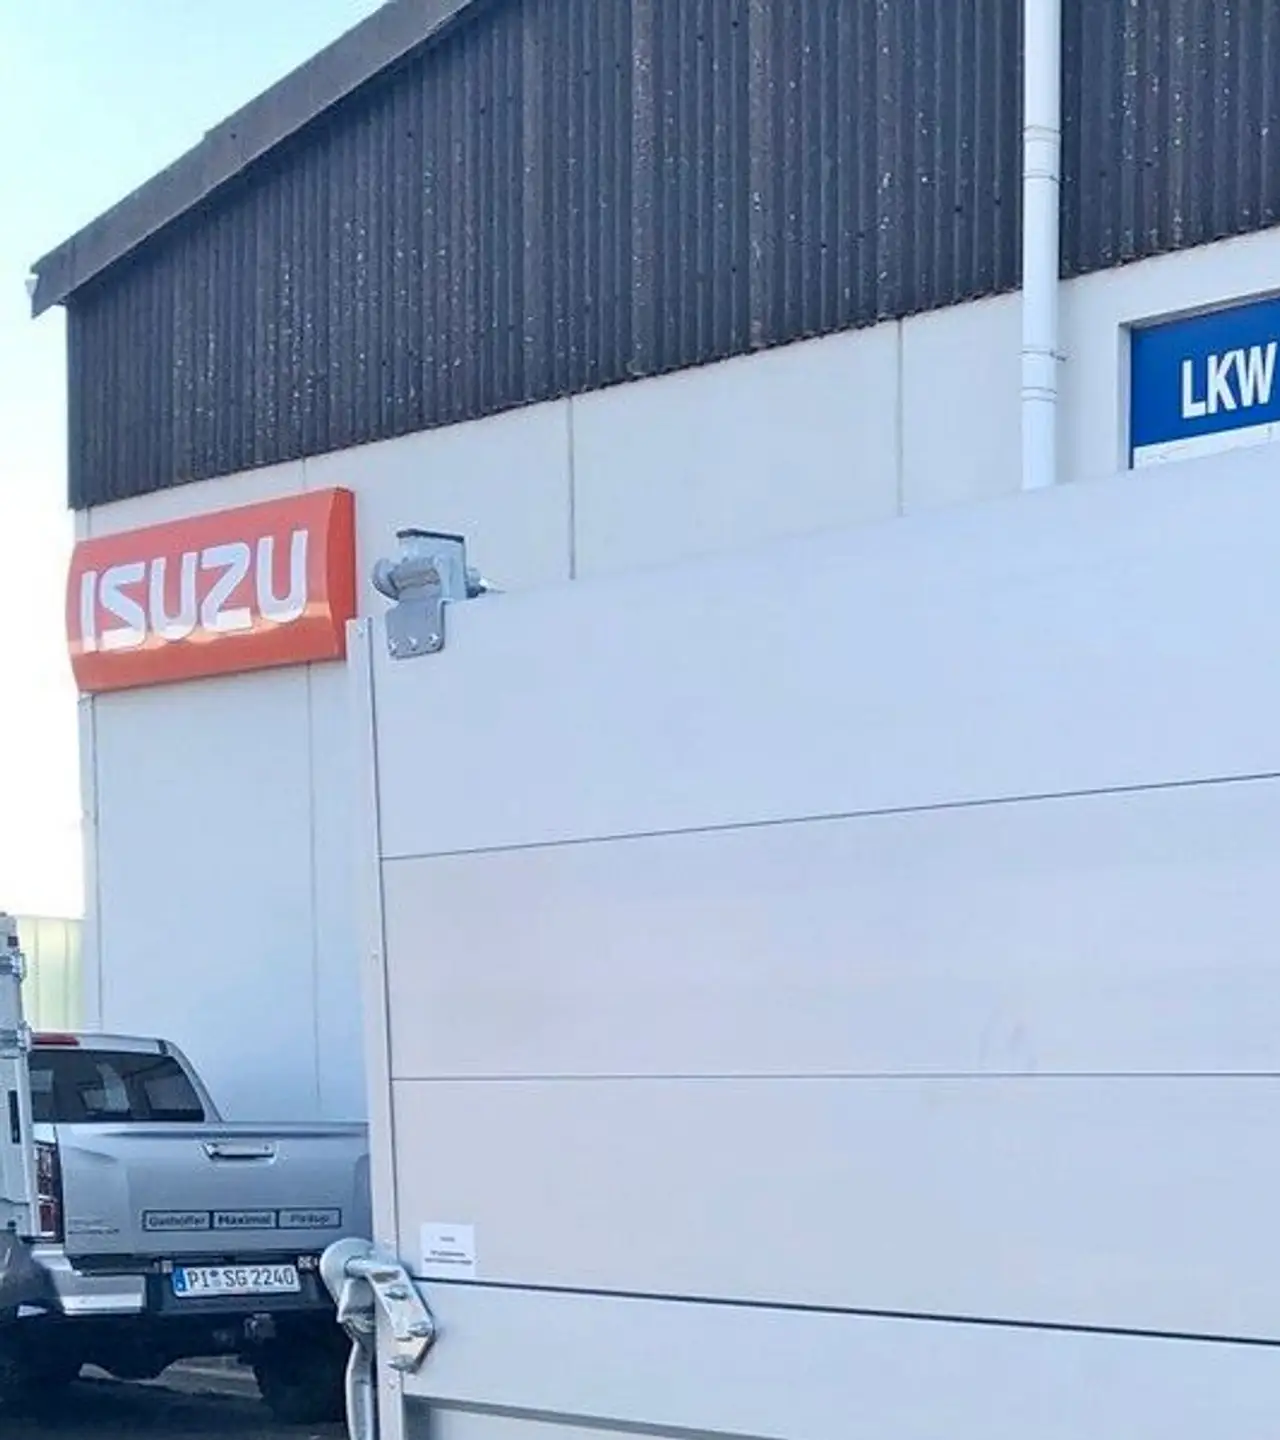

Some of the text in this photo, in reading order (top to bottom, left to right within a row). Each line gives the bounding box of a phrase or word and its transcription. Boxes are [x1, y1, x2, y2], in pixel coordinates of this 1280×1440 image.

[1182, 341, 1278, 419] LKW
[79, 528, 309, 654] ISUZU
[189, 1267, 295, 1288] PI SG 2240
